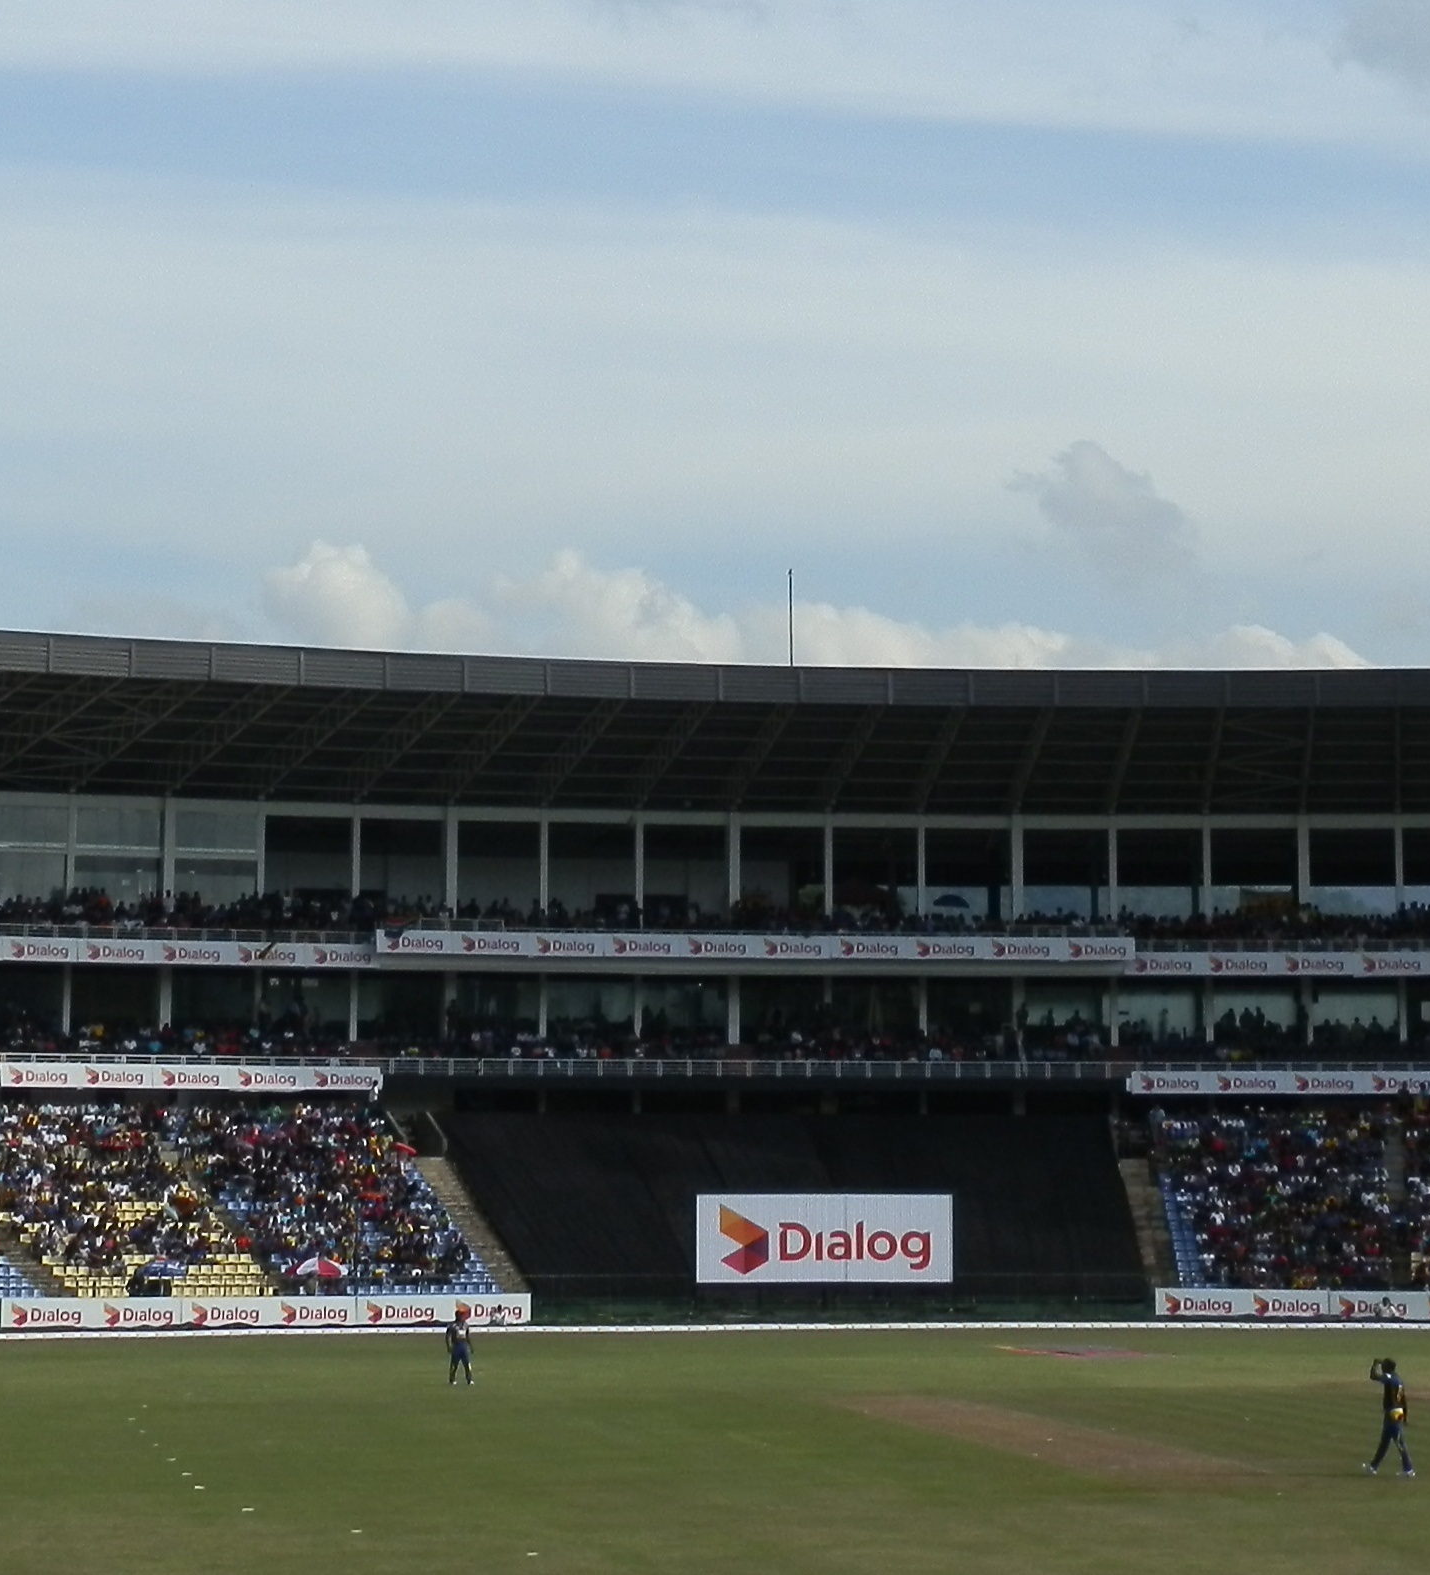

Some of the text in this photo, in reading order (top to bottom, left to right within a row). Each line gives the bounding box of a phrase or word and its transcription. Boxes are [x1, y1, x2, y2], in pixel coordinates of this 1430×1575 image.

[402, 936, 443, 951] Dialog
[478, 937, 519, 952] Dialog
[553, 938, 594, 954] Dialog
[629, 939, 670, 954] Dialog
[704, 941, 746, 955] Dialog
[780, 942, 821, 956] Dialog
[857, 942, 898, 955] Dialog
[933, 944, 974, 956] Dialog
[1008, 944, 1050, 957] Dialog
[27, 944, 69, 959] Dialog
[103, 946, 144, 960] Dialog
[179, 947, 220, 962] Dialog
[329, 949, 371, 964] Dialog
[1085, 944, 1126, 958] Dialog
[1150, 959, 1192, 971] Dialog
[1225, 959, 1267, 972] Dialog
[1302, 959, 1344, 972] Dialog
[1379, 959, 1421, 972] Dialog
[26, 1070, 67, 1084] Dialog
[102, 1071, 143, 1085] Dialog
[178, 1072, 219, 1086] Dialog
[255, 1073, 296, 1086] Dialog
[330, 1072, 372, 1087] Dialog
[1157, 1078, 1199, 1090] Dialog
[1234, 1078, 1276, 1090] Dialog
[1311, 1078, 1353, 1090] Dialog
[777, 1220, 931, 1270] Dialog
[1184, 1296, 1232, 1313] Dialog
[1271, 1299, 1320, 1316] Dialog
[31, 1308, 81, 1326] Dialog
[115, 1308, 166, 1325] Dialog
[211, 1307, 259, 1323] Dialog
[300, 1306, 347, 1322] Dialog
[385, 1304, 434, 1321] Dialog
